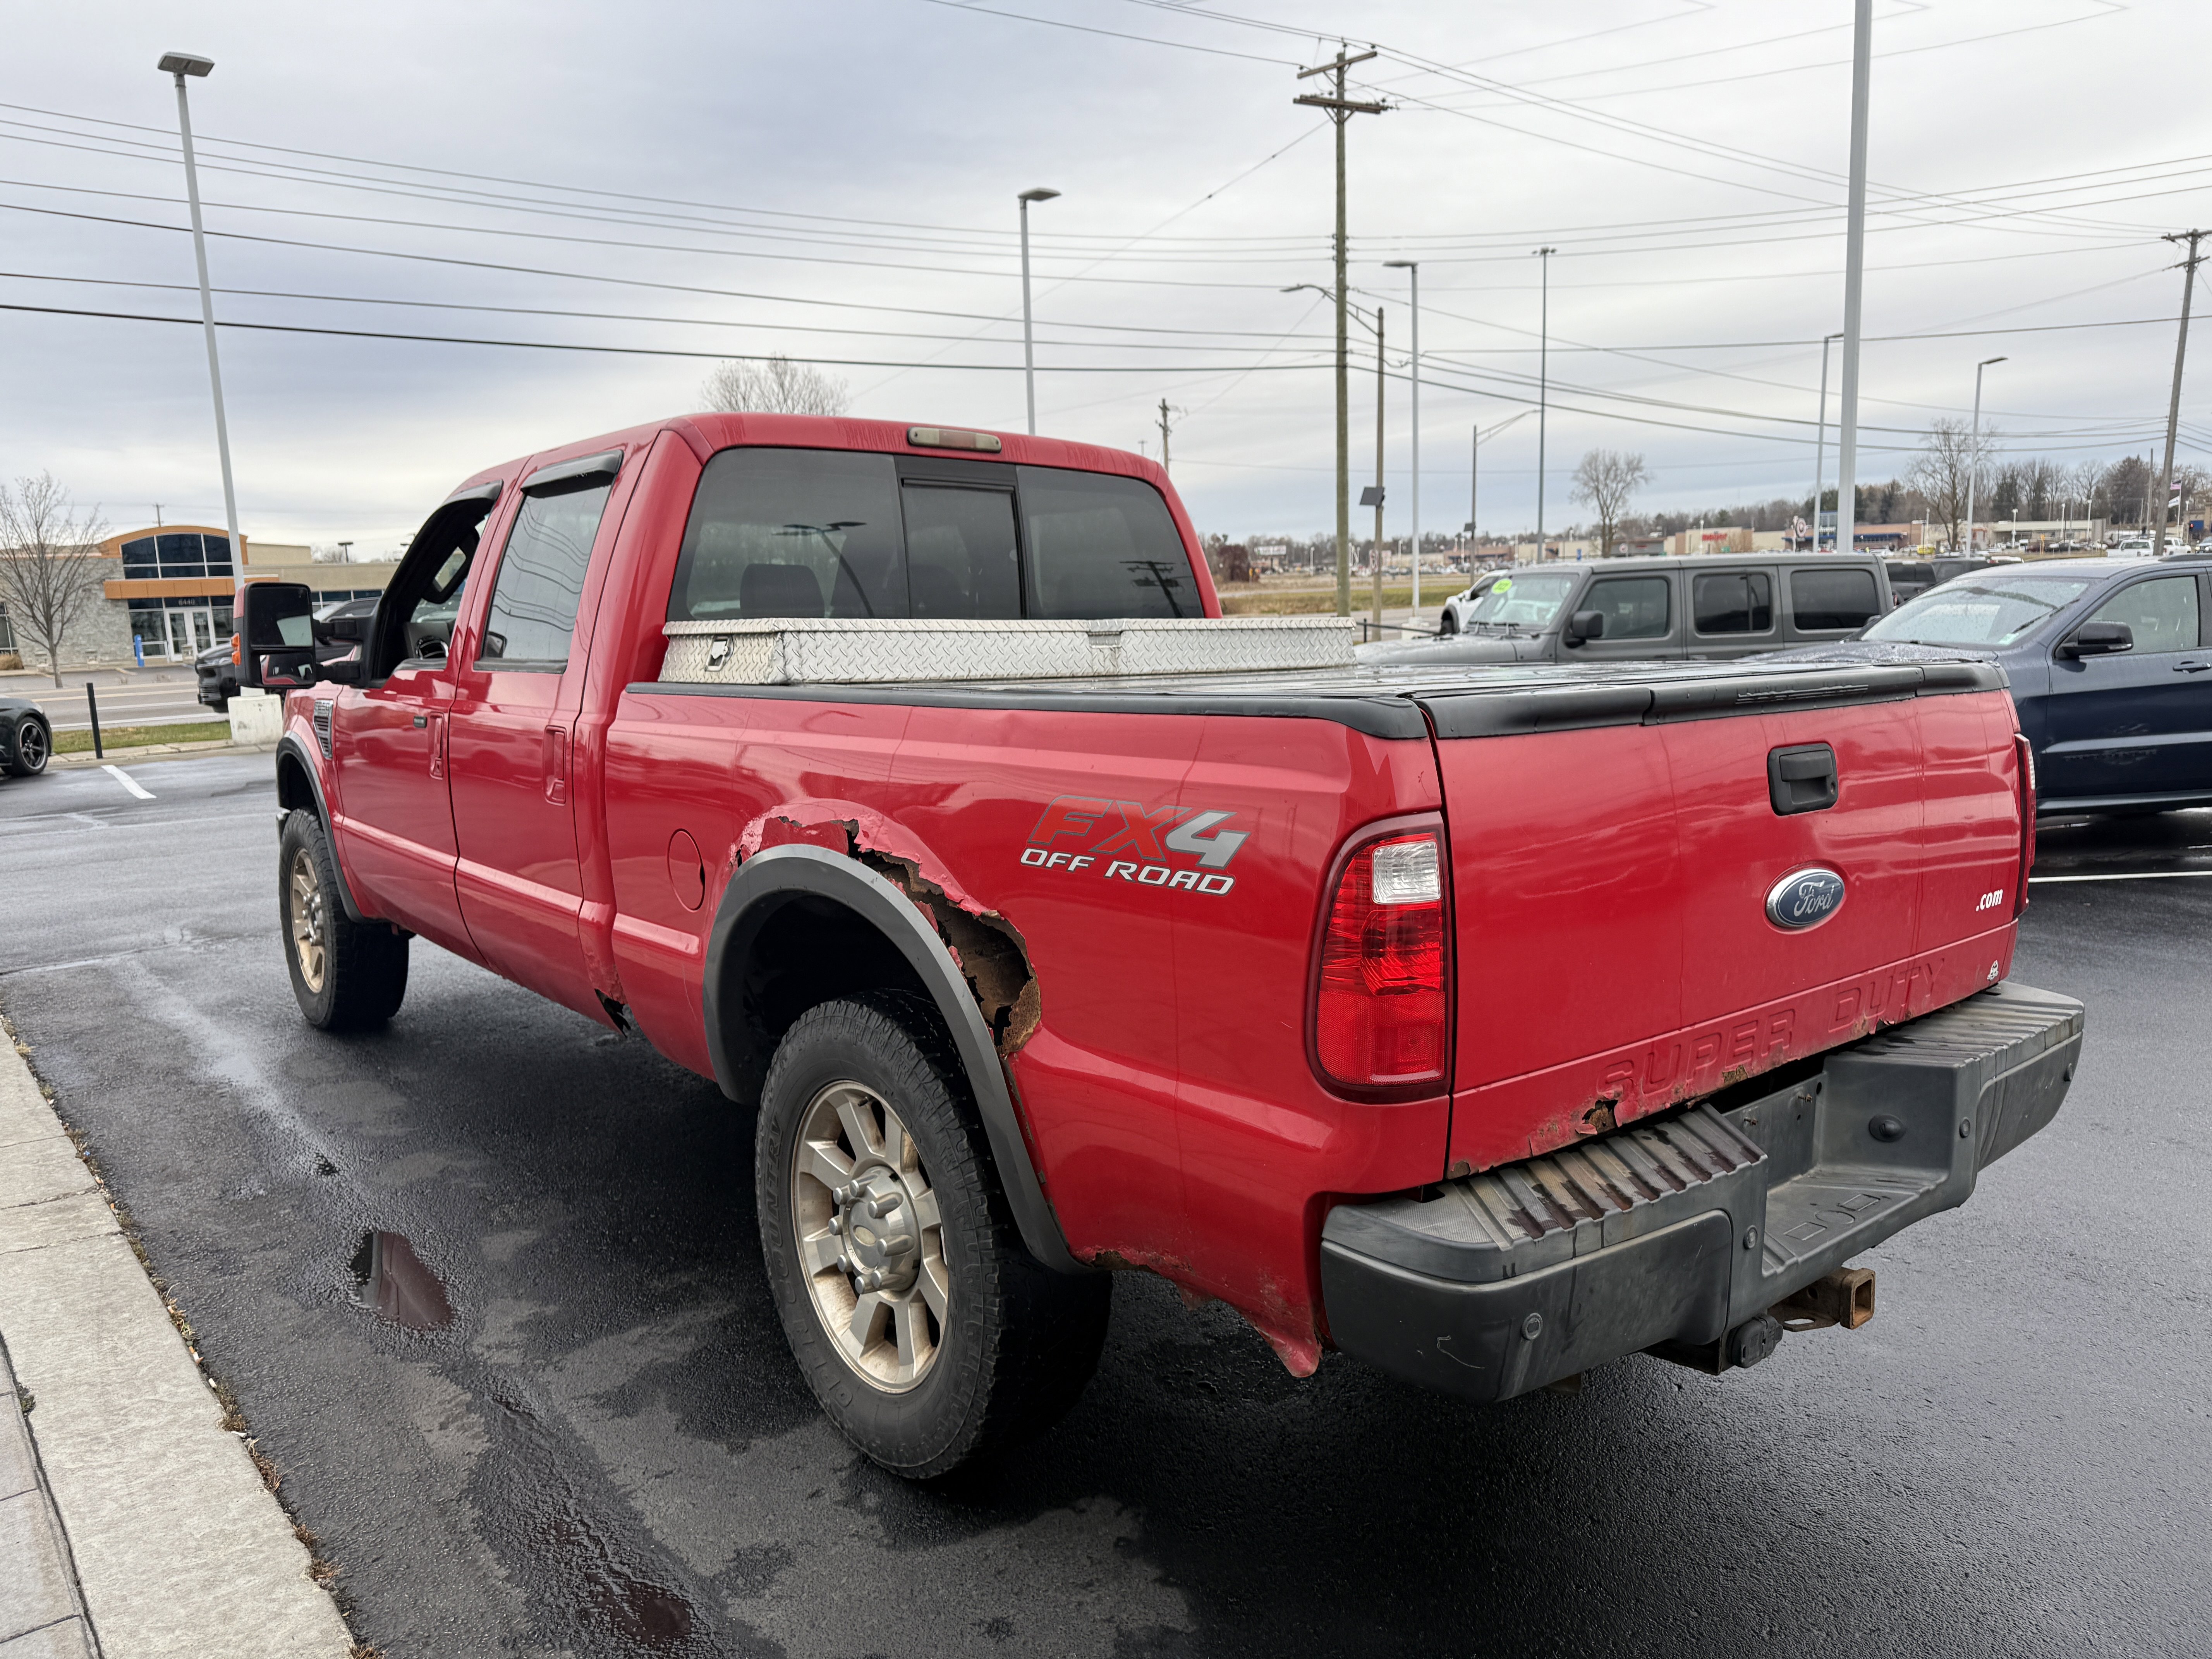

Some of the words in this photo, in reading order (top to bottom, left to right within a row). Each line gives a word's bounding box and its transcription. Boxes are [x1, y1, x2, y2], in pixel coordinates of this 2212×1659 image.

[1027, 795, 1251, 870] FX4
[1020, 848, 1096, 872] OFF
[1104, 860, 1237, 896] ROAD
[1794, 880, 1834, 917] Ford
[1976, 889, 2003, 912] .com
[1596, 1008, 1796, 1098] SUPER
[1827, 958, 1945, 1033] DUTY
[765, 1112, 797, 1304] COUNTRY
